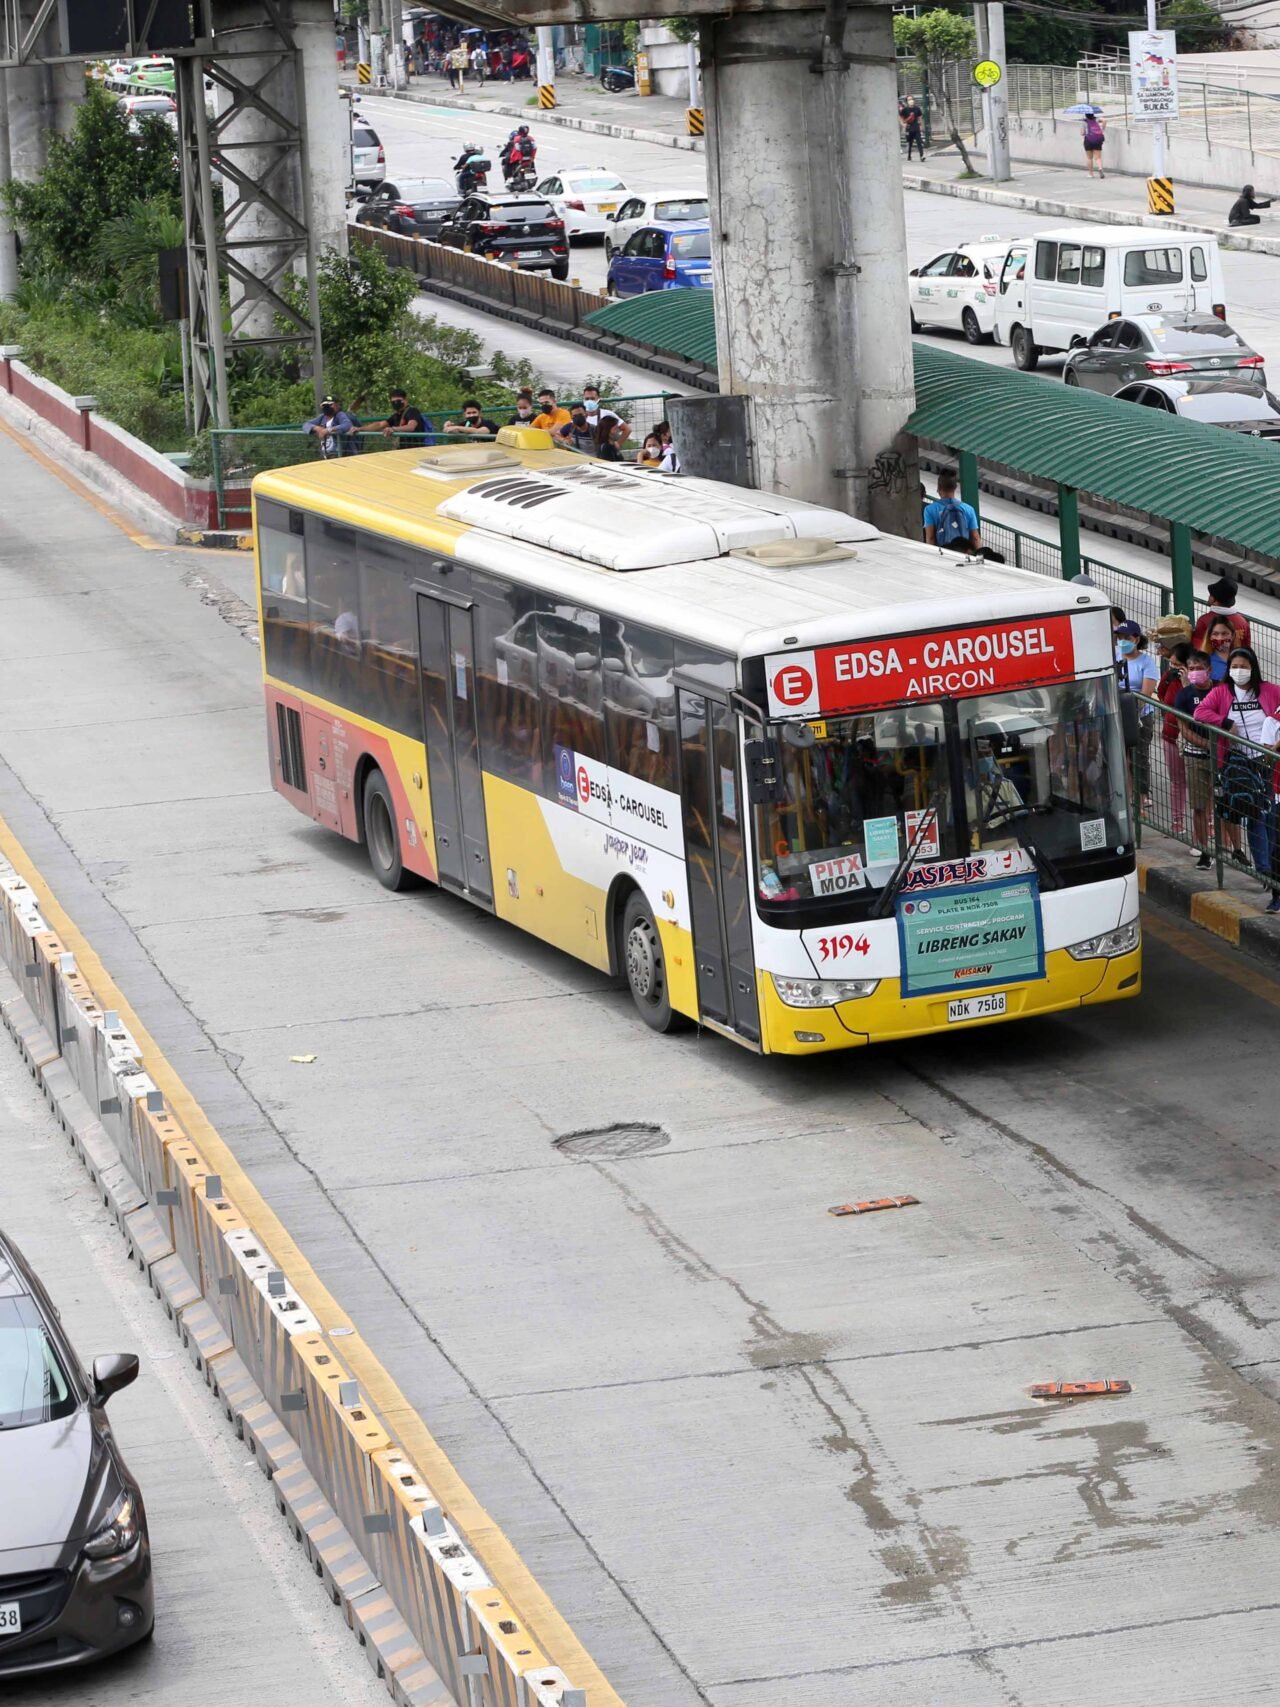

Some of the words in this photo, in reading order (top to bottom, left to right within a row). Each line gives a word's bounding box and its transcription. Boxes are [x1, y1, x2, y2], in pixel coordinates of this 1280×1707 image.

[1144, 102, 1169, 111] BUKAS
[782, 672, 804, 700] E
[834, 648, 903, 681] EDSA
[923, 627, 1054, 670] CAROUSEL
[906, 668, 994, 697] AIRCON
[580, 772, 588, 798] E
[590, 780, 613, 806] EDSA
[620, 794, 668, 830] CAROUSEL
[815, 856, 861, 880] PITX
[820, 874, 860, 894] MOA
[938, 906, 959, 914] PLATE
[916, 924, 944, 936] SERVICE
[946, 920, 992, 931] CONTRACTING
[992, 914, 1025, 924] PROGRAM
[817, 933, 870, 962] 3194
[918, 934, 980, 954] LIBRENG
[982, 926, 1026, 945] SAKAY
[950, 1002, 970, 1017] NDK
[978, 998, 1004, 1012] 7508
